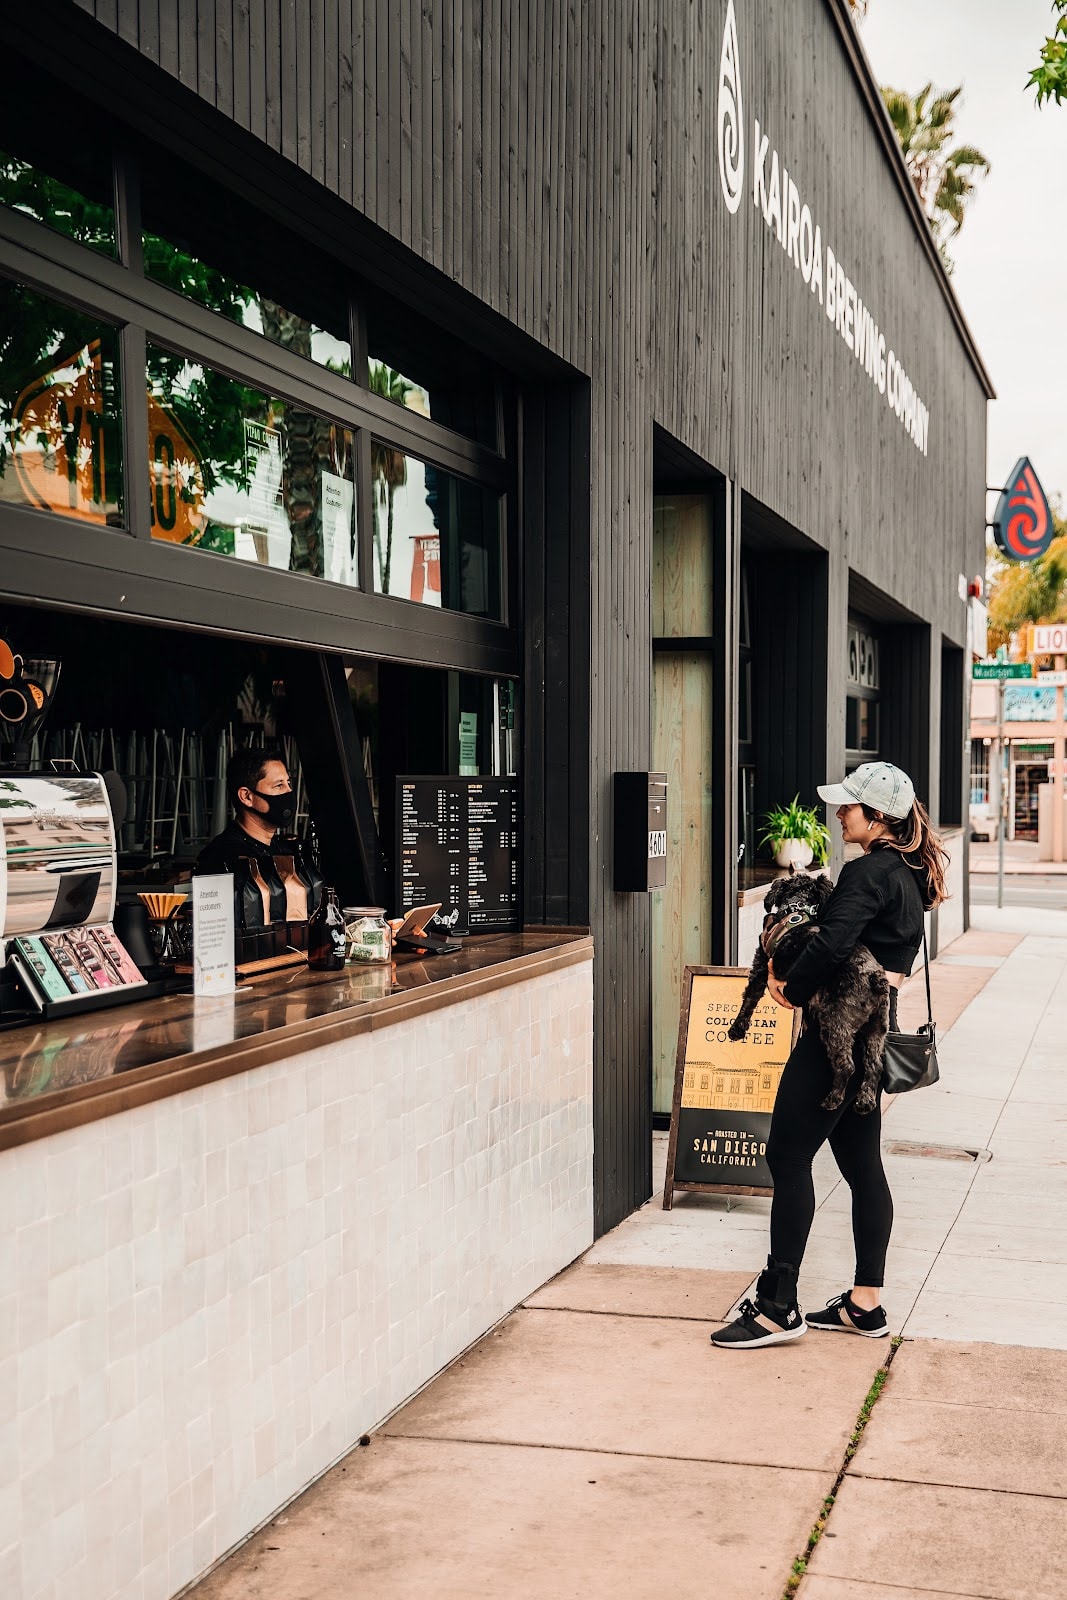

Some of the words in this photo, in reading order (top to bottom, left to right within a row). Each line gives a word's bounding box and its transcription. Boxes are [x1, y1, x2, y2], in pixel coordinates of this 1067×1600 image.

[753, 118, 823, 306] KAIROA
[826, 246, 886, 395] BREWING
[887, 349, 930, 457] COMPANY
[649, 832, 665, 855] 4601
[707, 1003, 778, 1014] SPECLTY
[705, 1016, 777, 1028] COLOIAN
[705, 1030, 775, 1045] COFEE
[715, 1130, 738, 1139] ROASTED
[740, 1131, 747, 1139] IN
[693, 1138, 718, 1153] SAN
[725, 1140, 767, 1156] DIEGO
[700, 1154, 757, 1167] CALIFORNIA
